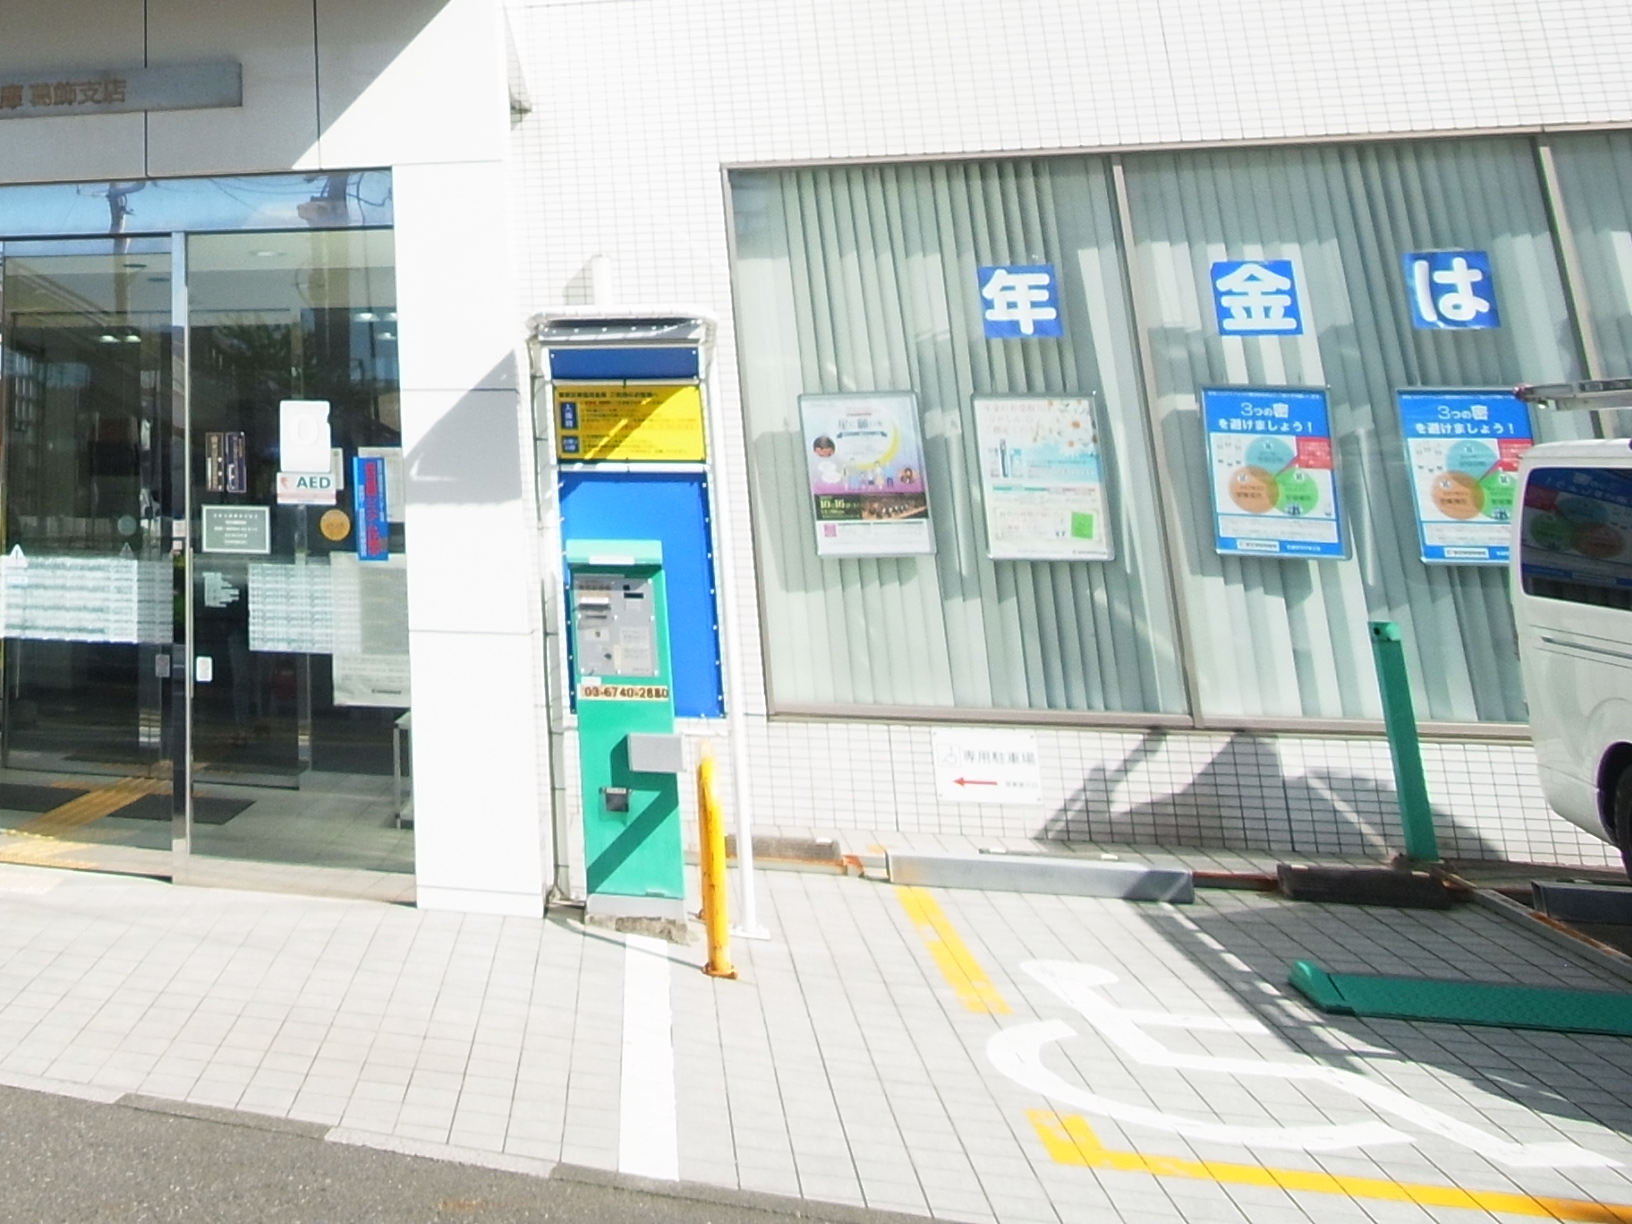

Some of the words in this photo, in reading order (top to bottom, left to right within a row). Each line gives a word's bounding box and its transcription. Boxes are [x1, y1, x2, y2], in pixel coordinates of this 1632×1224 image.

[982, 269, 1057, 334] 年
[1218, 263, 1297, 330] 金
[1416, 256, 1491, 324] は
[296, 475, 331, 489] AED
